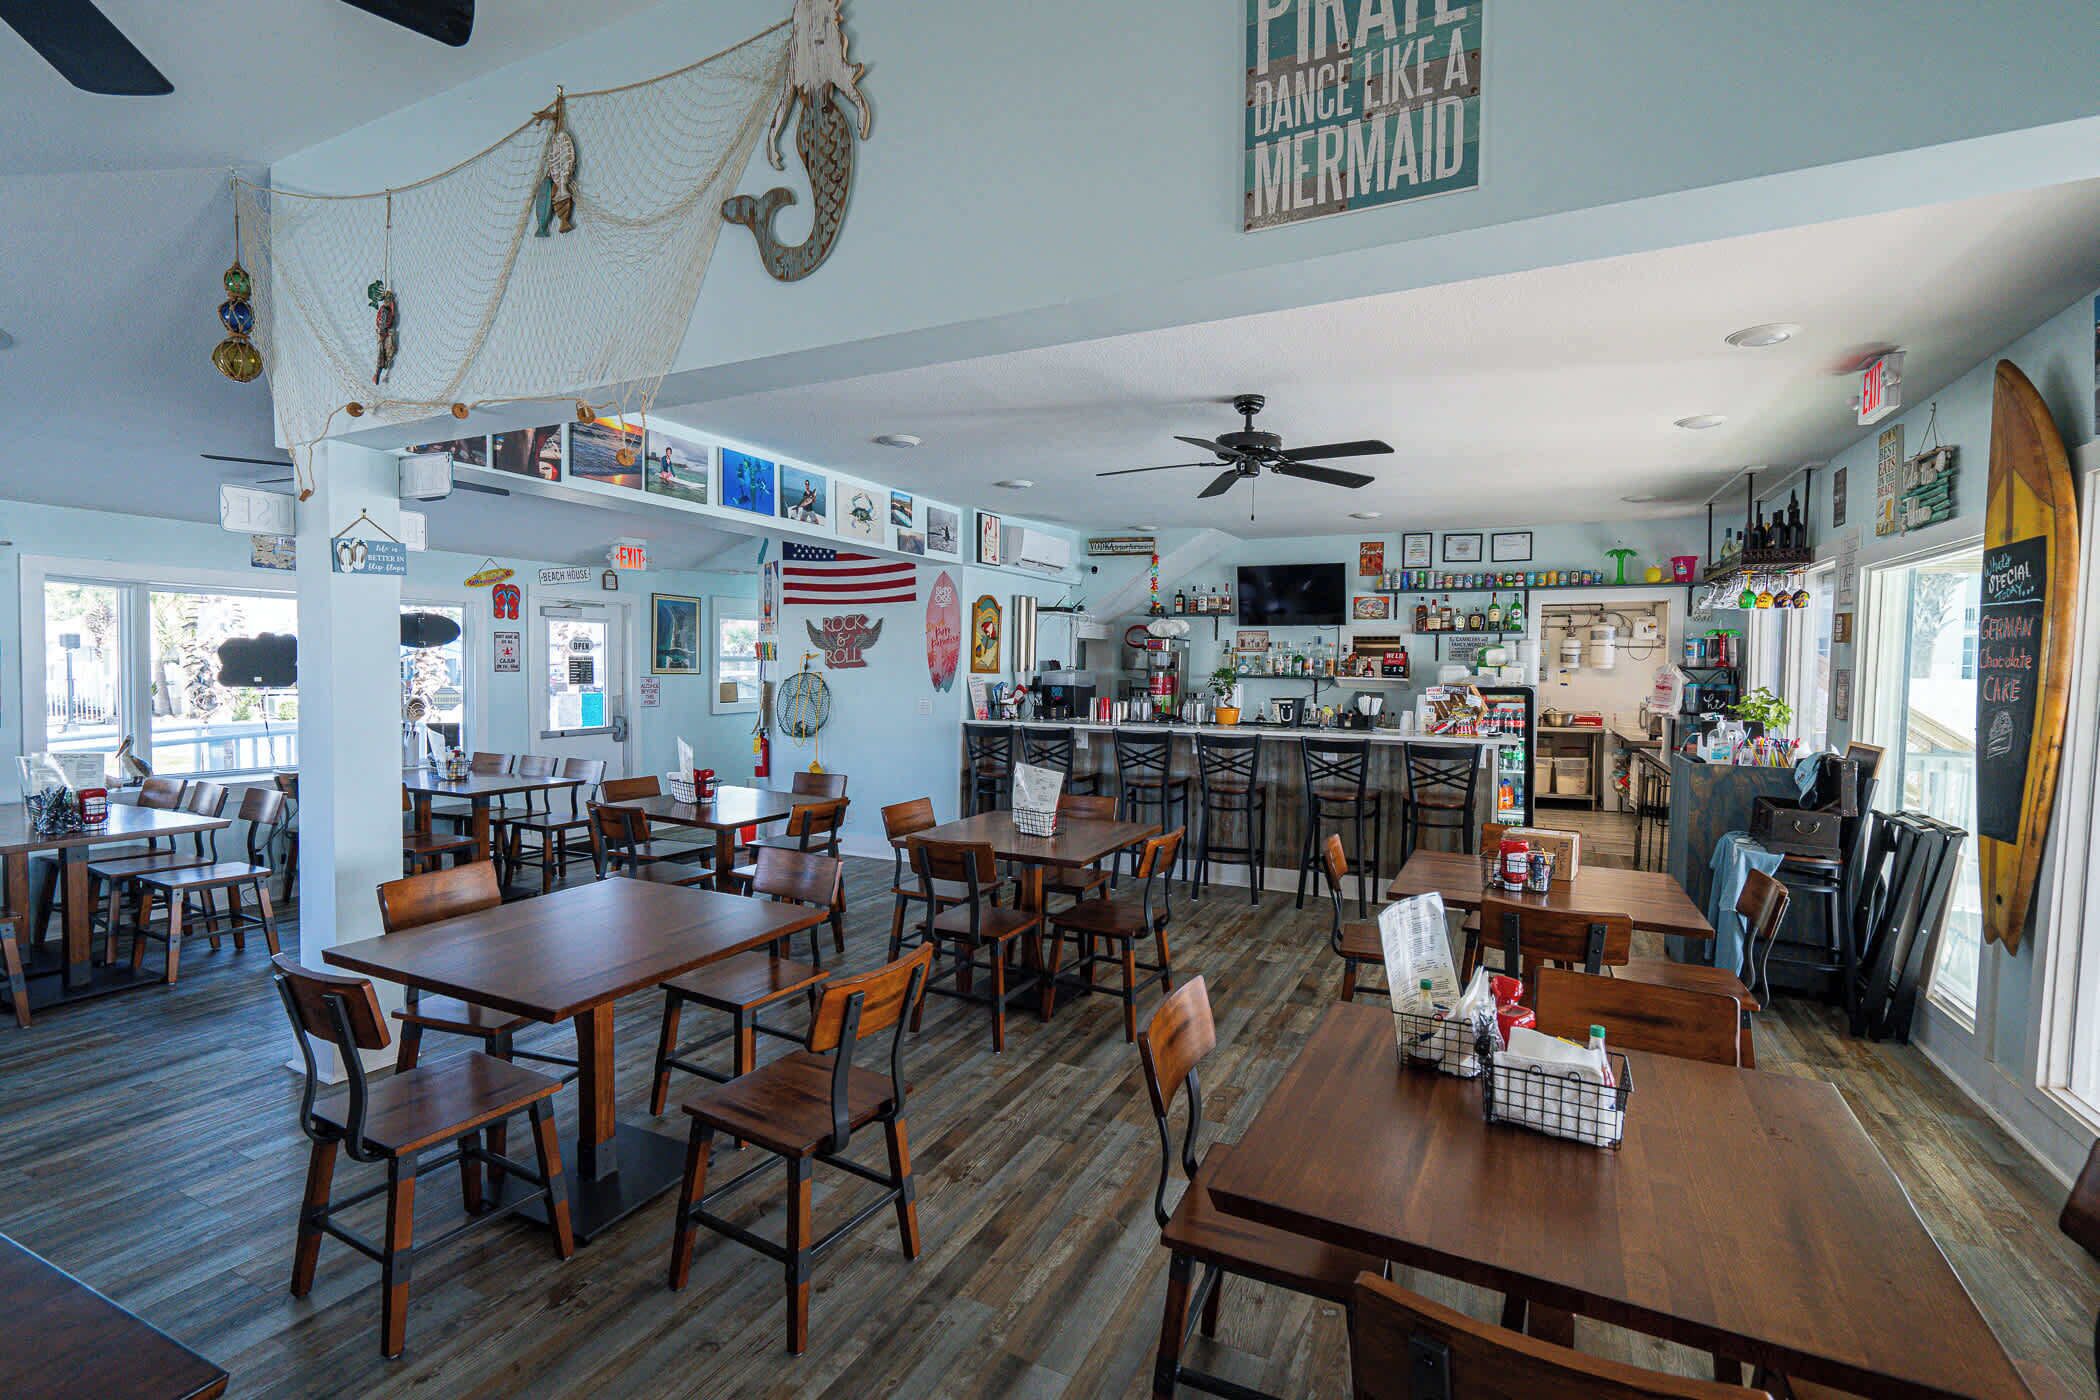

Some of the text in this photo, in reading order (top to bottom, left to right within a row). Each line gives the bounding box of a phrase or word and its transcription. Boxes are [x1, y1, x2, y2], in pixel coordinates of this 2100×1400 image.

[1254, 28, 1469, 137] DANCE LIKE A
[1253, 96, 1465, 217] MERMAID
[1862, 361, 1882, 415] EXIT
[620, 546, 643, 569] EXIT
[1984, 553, 2012, 577] What's
[543, 568, 588, 581] BEACH HOUSE
[1989, 561, 2032, 594] SPECIAL
[823, 614, 866, 632] ROCK
[1981, 615, 2034, 641] GERMAN
[573, 642, 590, 650] OPEN
[837, 633, 850, 647] &
[825, 647, 862, 665] ROLL
[1980, 647, 2033, 670] Chocolate
[1983, 676, 2025, 703] CAKE
